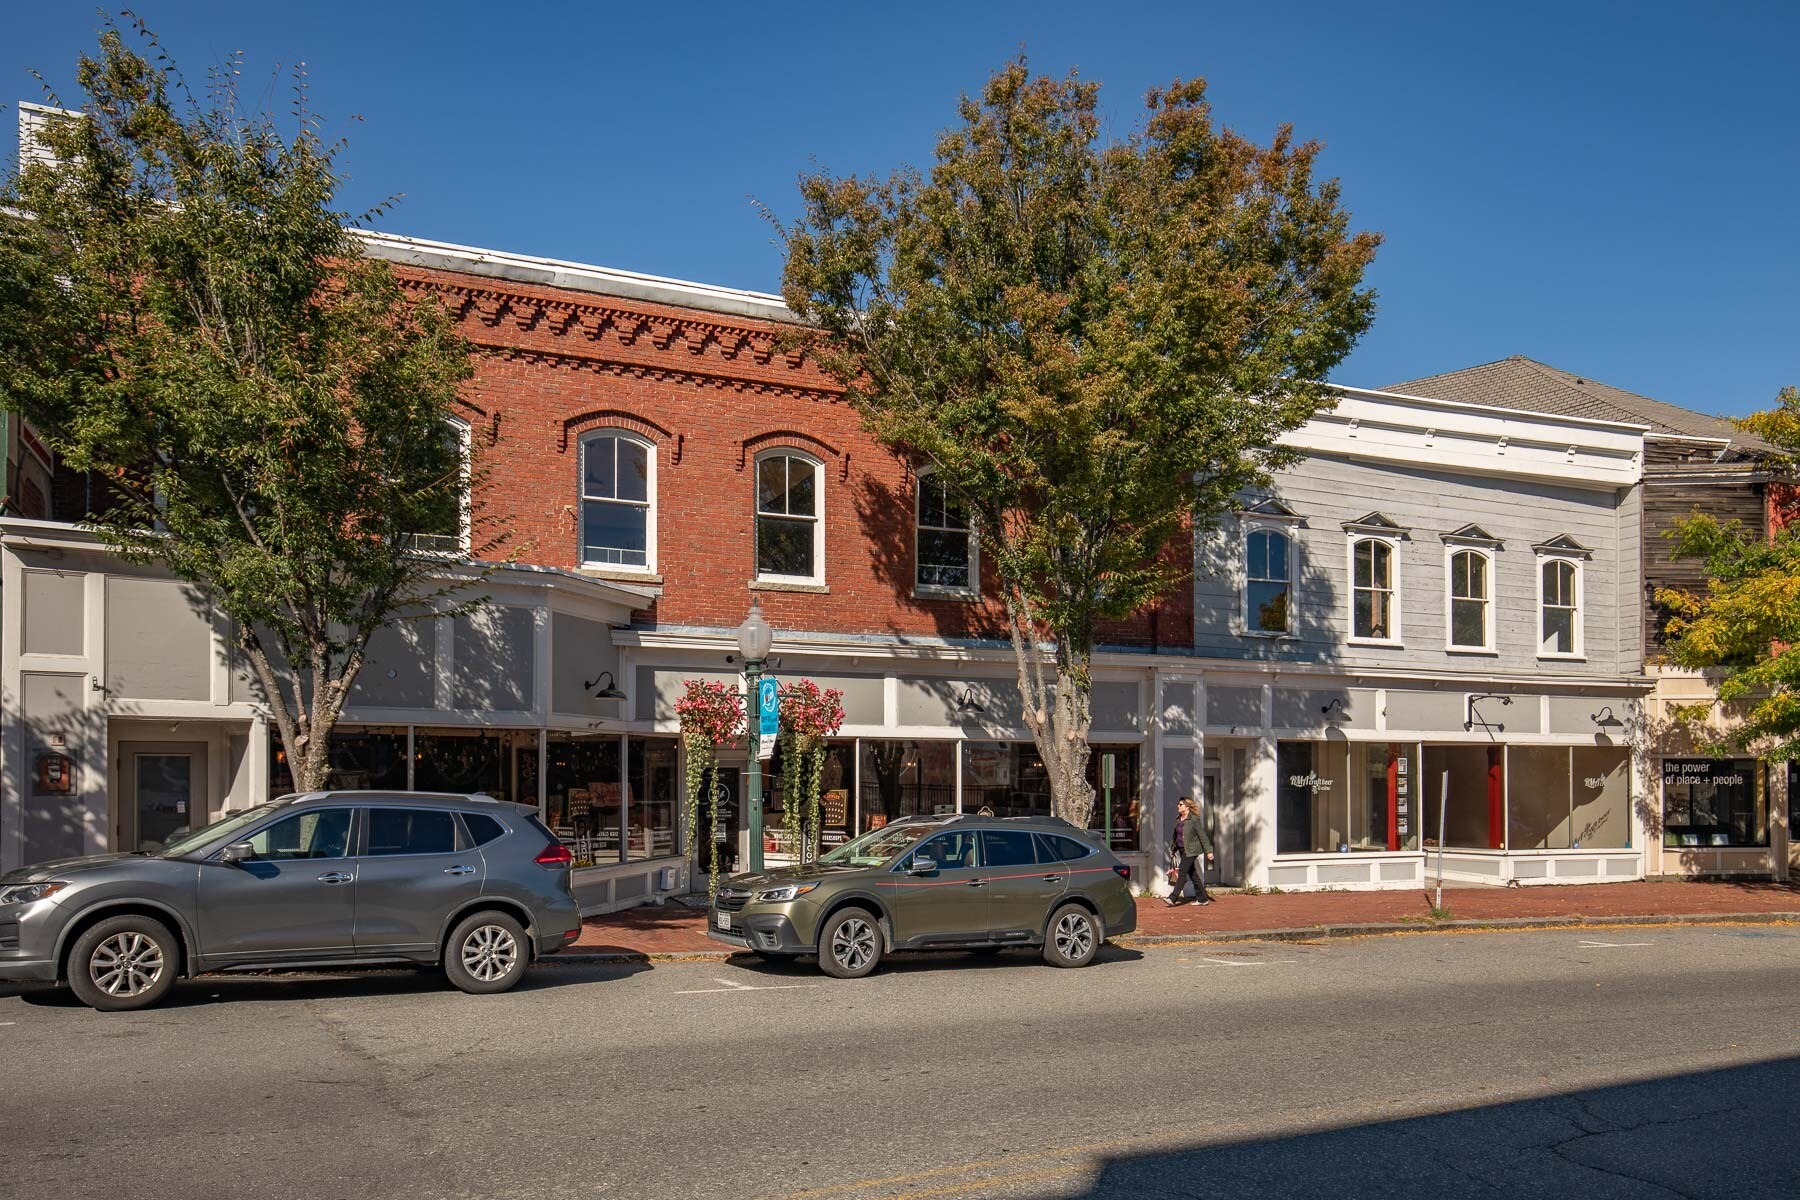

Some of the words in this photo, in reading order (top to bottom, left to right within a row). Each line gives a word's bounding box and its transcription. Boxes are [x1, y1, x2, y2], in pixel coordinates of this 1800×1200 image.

[1665, 762, 1680, 773] the
[1681, 763, 1711, 775] power
[1665, 774, 1675, 785] of
[1677, 774, 1701, 787] place
[1713, 773, 1743, 787] people
